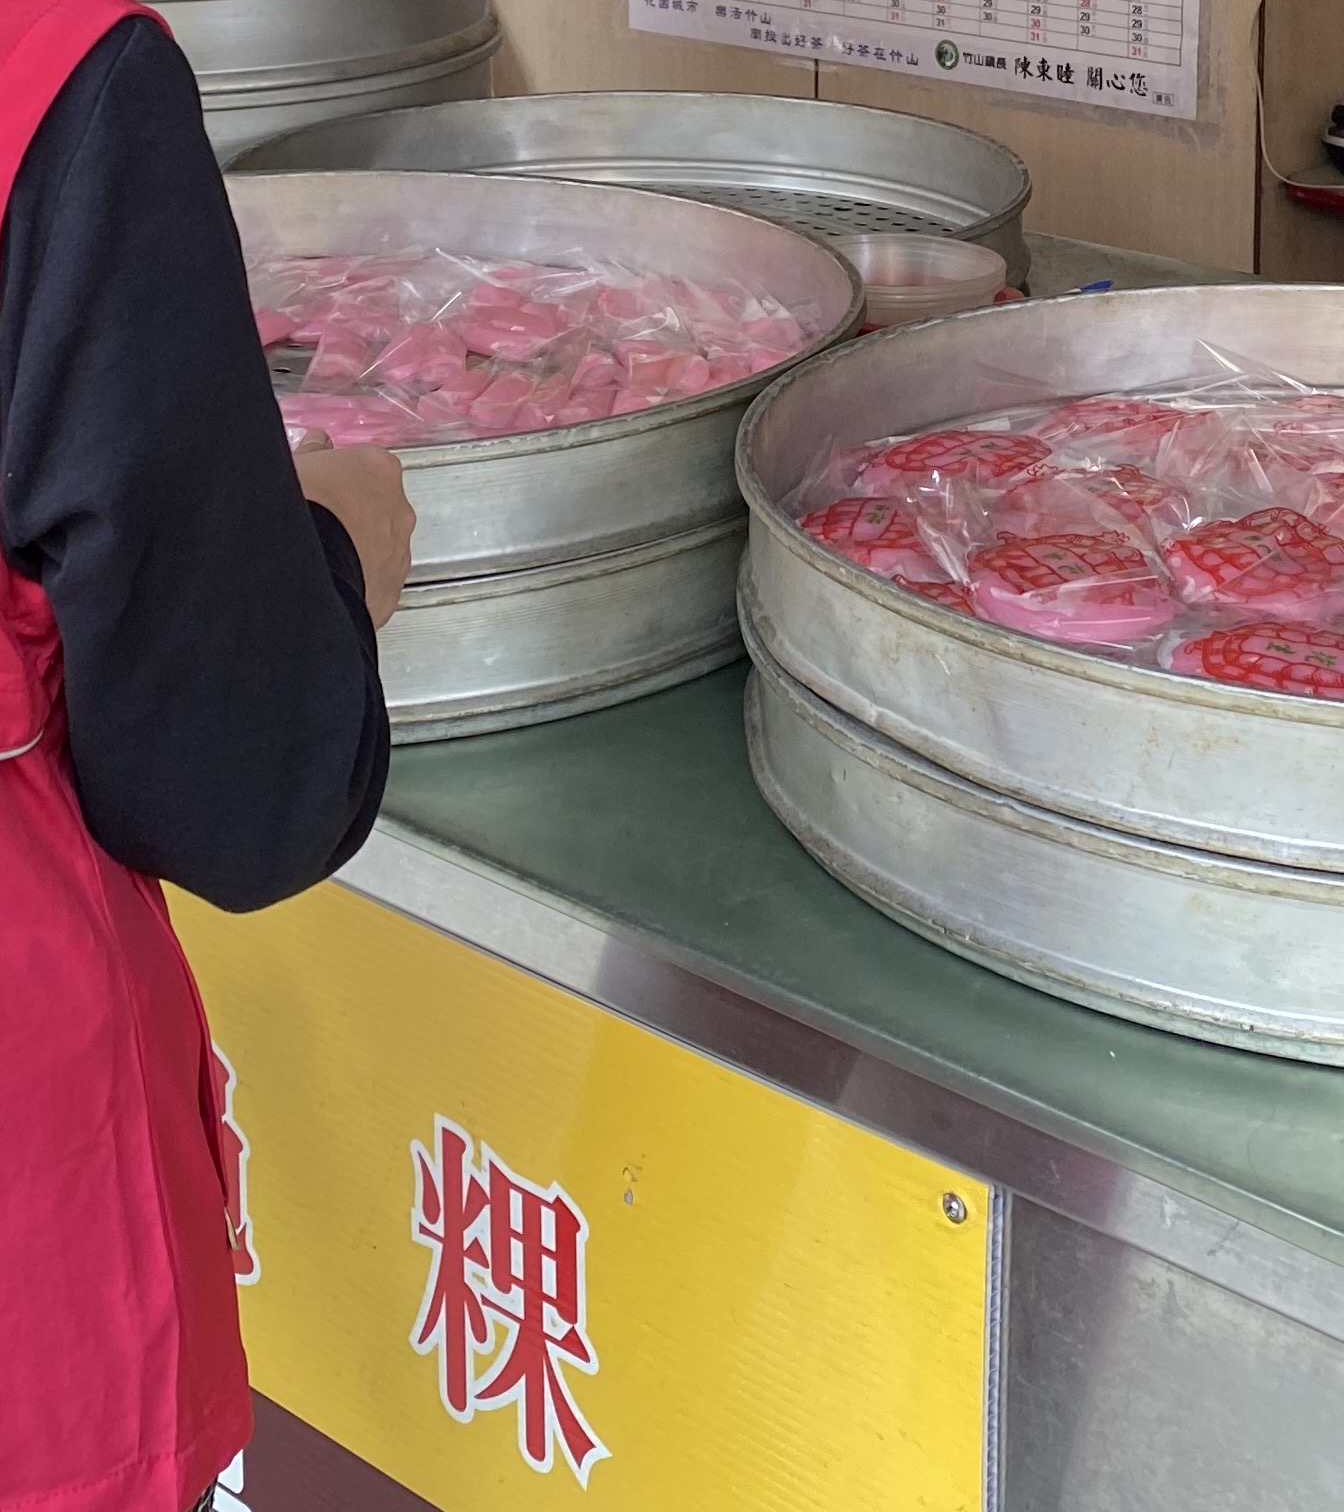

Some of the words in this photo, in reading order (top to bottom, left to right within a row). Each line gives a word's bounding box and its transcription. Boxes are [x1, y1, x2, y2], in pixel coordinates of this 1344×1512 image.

[1014, 55, 1075, 85] 陳東睦
[1086, 65, 1148, 97] 關心您
